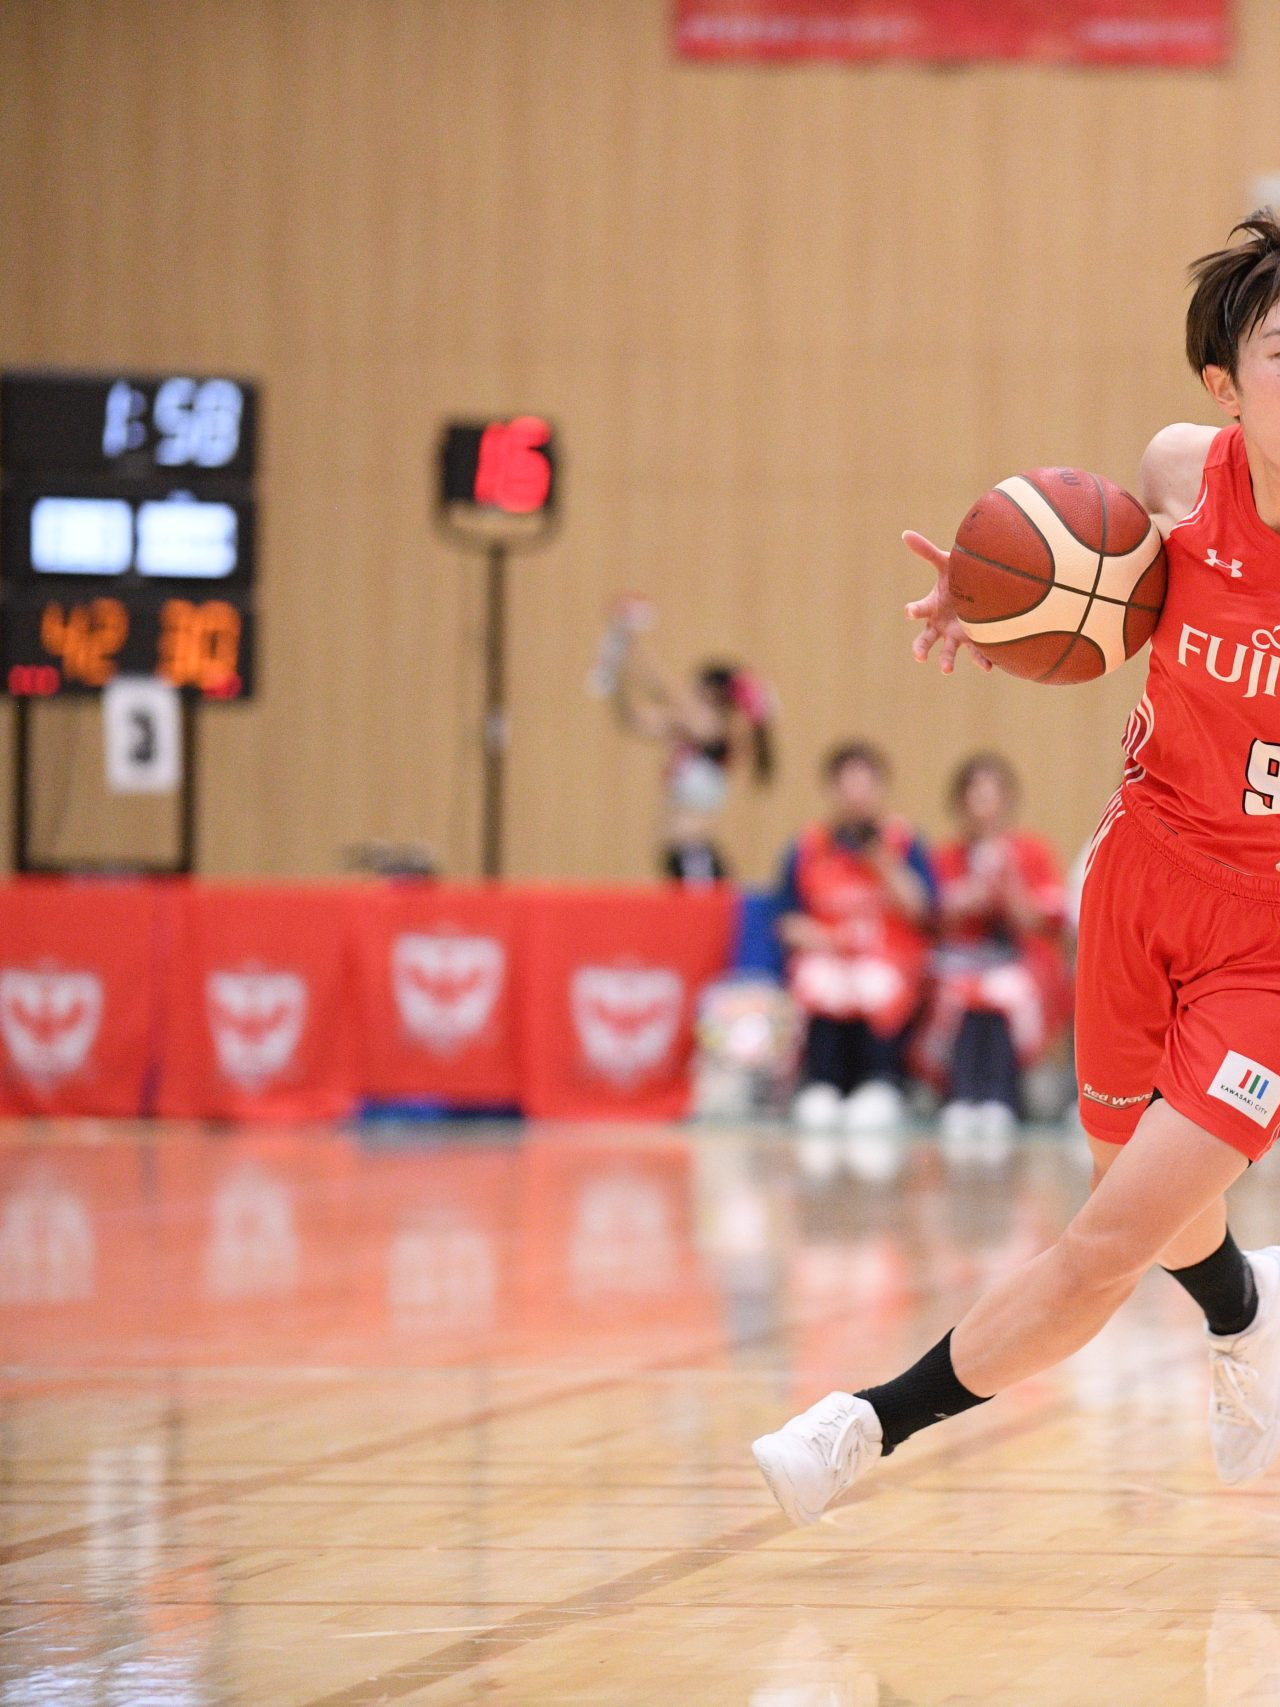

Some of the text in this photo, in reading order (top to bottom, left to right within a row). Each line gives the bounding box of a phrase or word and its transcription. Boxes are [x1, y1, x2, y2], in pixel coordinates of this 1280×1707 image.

[1083, 1083, 1109, 1102] Red
[1220, 1084, 1268, 1115] KAWASAKI CITY
